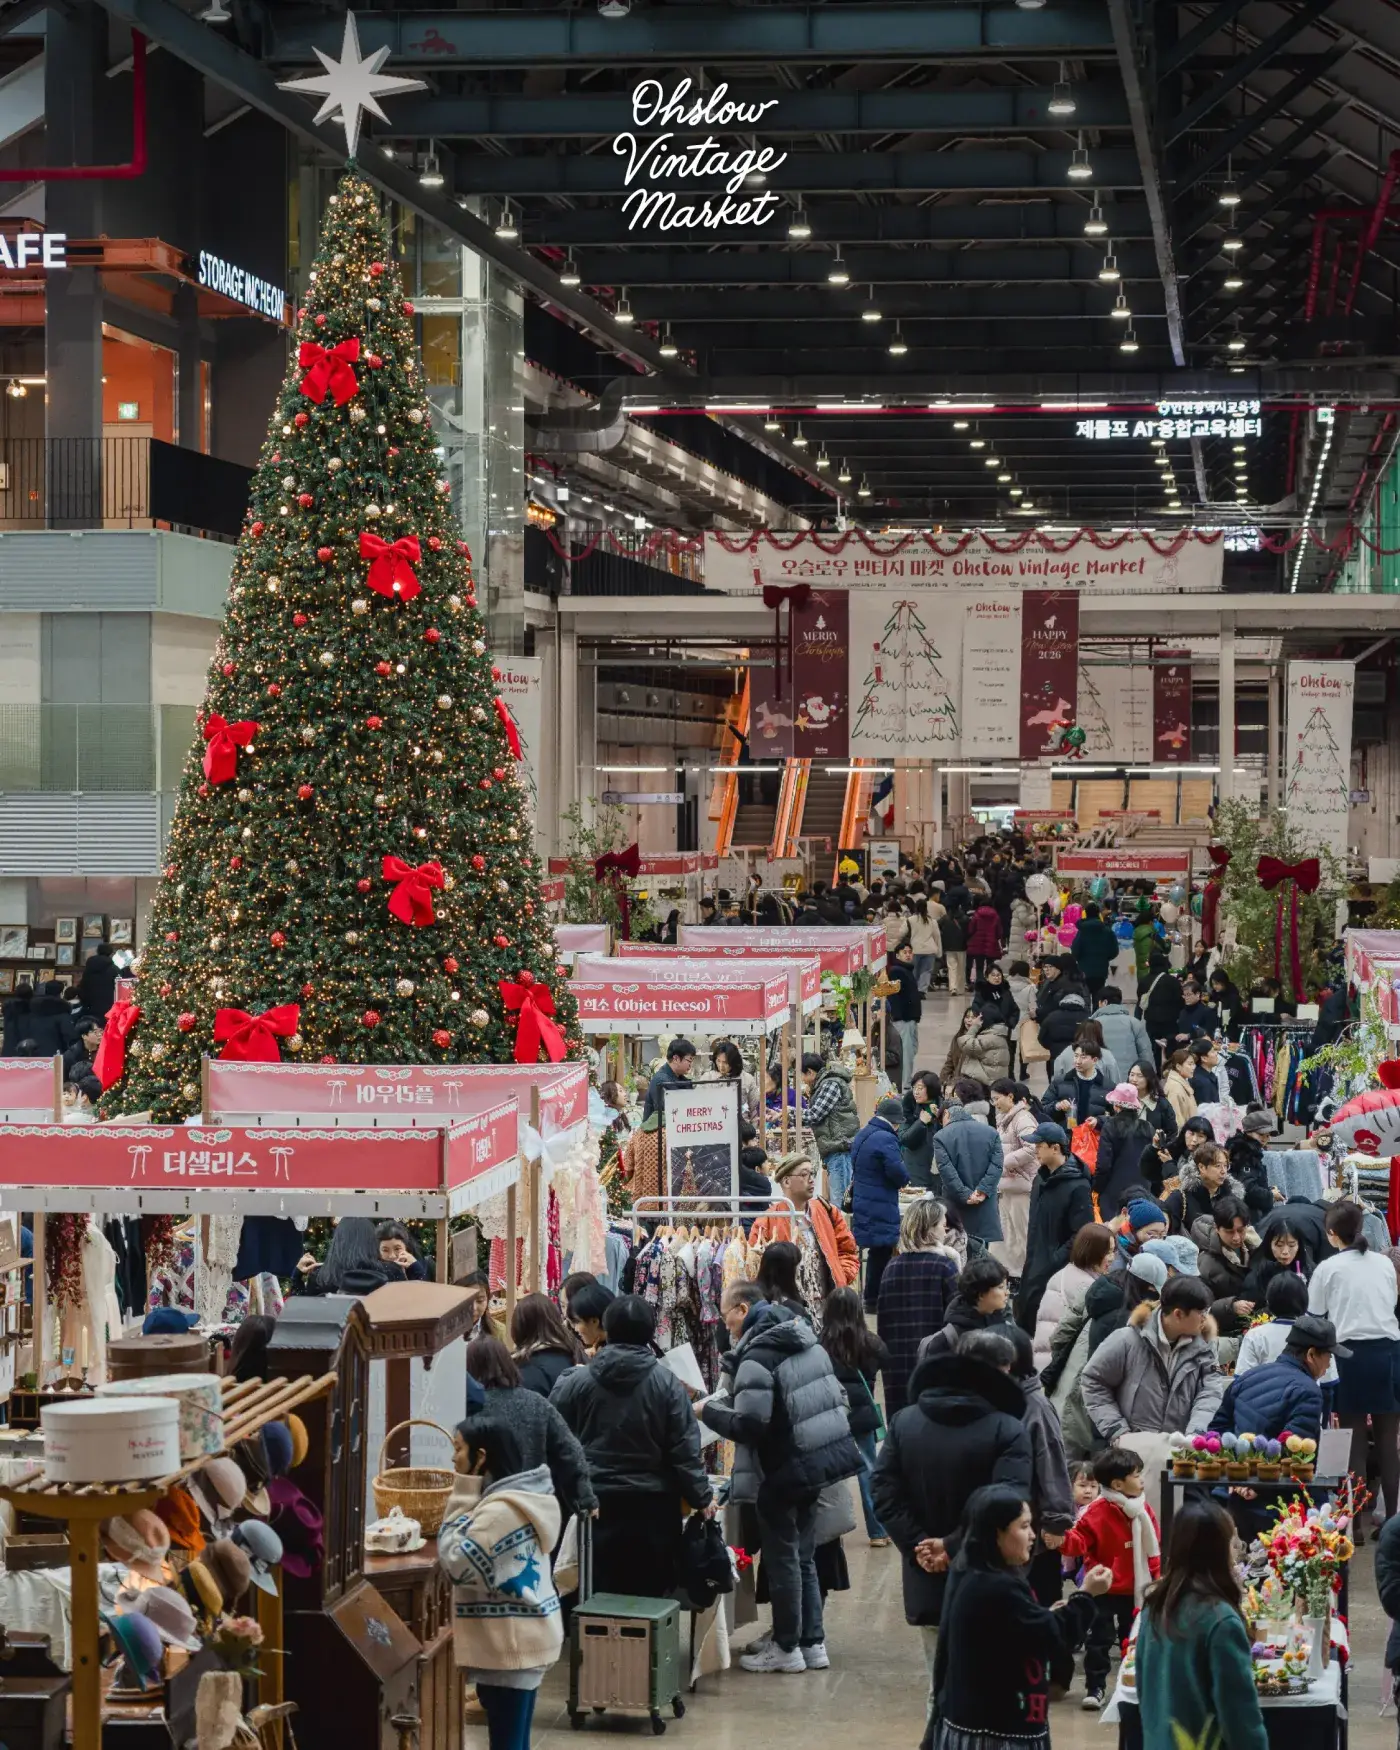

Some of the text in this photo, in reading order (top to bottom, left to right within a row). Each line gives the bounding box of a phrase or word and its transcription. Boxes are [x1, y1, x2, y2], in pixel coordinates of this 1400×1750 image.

[199, 250, 285, 321] STORAGE INCHEON
[781, 557, 1146, 580] 오슬로우 빈티지 마켓 Ohslow Vintage Market
[802, 631, 838, 641] MERRY
[1032, 630, 1068, 640] HAPPY
[1038, 650, 1062, 660] 2026
[583, 998, 610, 1012] 희소
[614, 998, 658, 1013] (Objet
[661, 999, 711, 1013] Heeso)
[686, 1107, 713, 1118] MERRY
[676, 1121, 724, 1133] CHRISTMAS
[163, 1151, 258, 1176] 더샐리스
